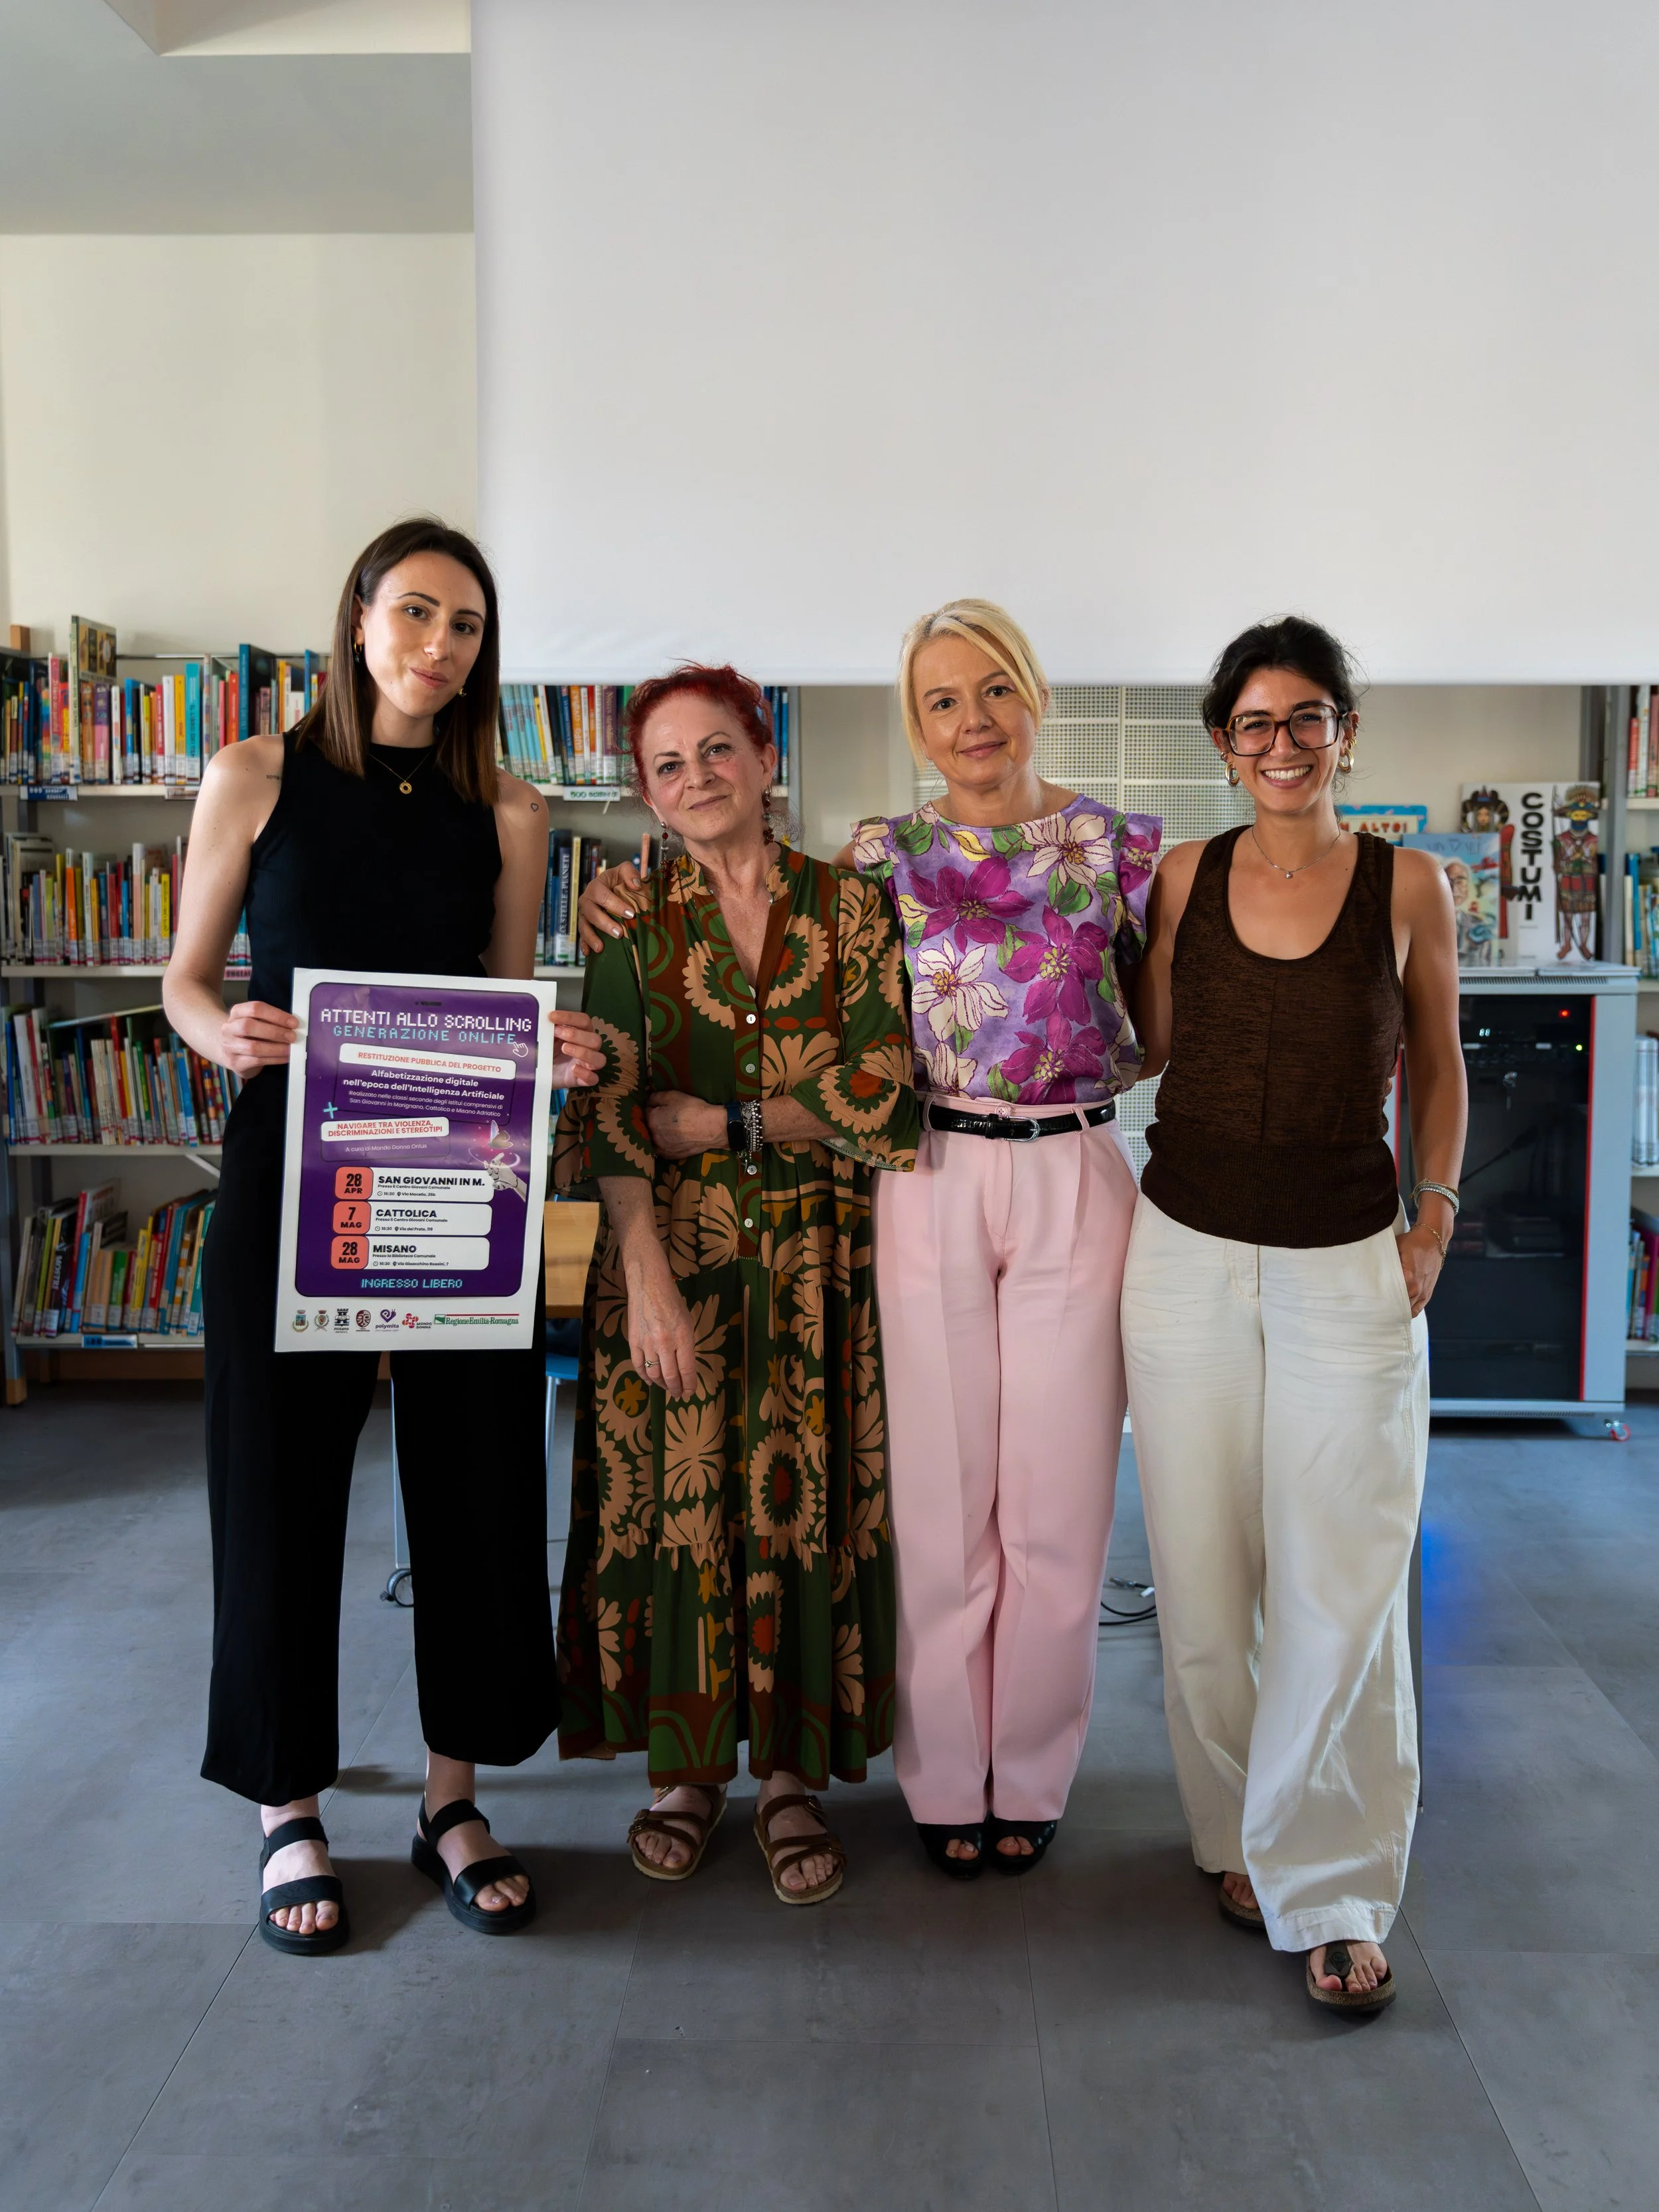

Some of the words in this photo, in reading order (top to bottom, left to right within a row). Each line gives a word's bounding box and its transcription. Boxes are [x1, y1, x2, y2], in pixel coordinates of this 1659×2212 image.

[1518, 792, 1544, 921] COSTUMI
[321, 1009, 390, 1025] ATTENTI
[397, 1012, 438, 1027] ALLO
[445, 1015, 532, 1032] SCROLLING
[333, 1025, 449, 1041] GENERAZIONE
[459, 1031, 516, 1045] ONLIFE
[358, 1052, 409, 1063] RESTITUZIONE
[411, 1057, 447, 1067] PUBBLICA
[463, 1063, 501, 1072] PROGETTO
[372, 1070, 444, 1083] Alfabetizzazione
[445, 1077, 478, 1087] digitale
[461, 1090, 505, 1100] Artificiale
[328, 1128, 394, 1137] DISCRIMINAZIONI
[346, 1173, 362, 1187] 28
[403, 1177, 457, 1185] GIOVANNI
[348, 1207, 356, 1220] 7
[376, 1209, 437, 1218] CATTOLICA
[342, 1241, 358, 1256] 28
[373, 1244, 417, 1253] MISANO
[52, 1255, 63, 1291] MOSTRI
[361, 1278, 418, 1288] INGRESSO
[422, 1279, 463, 1288] LIBERO
